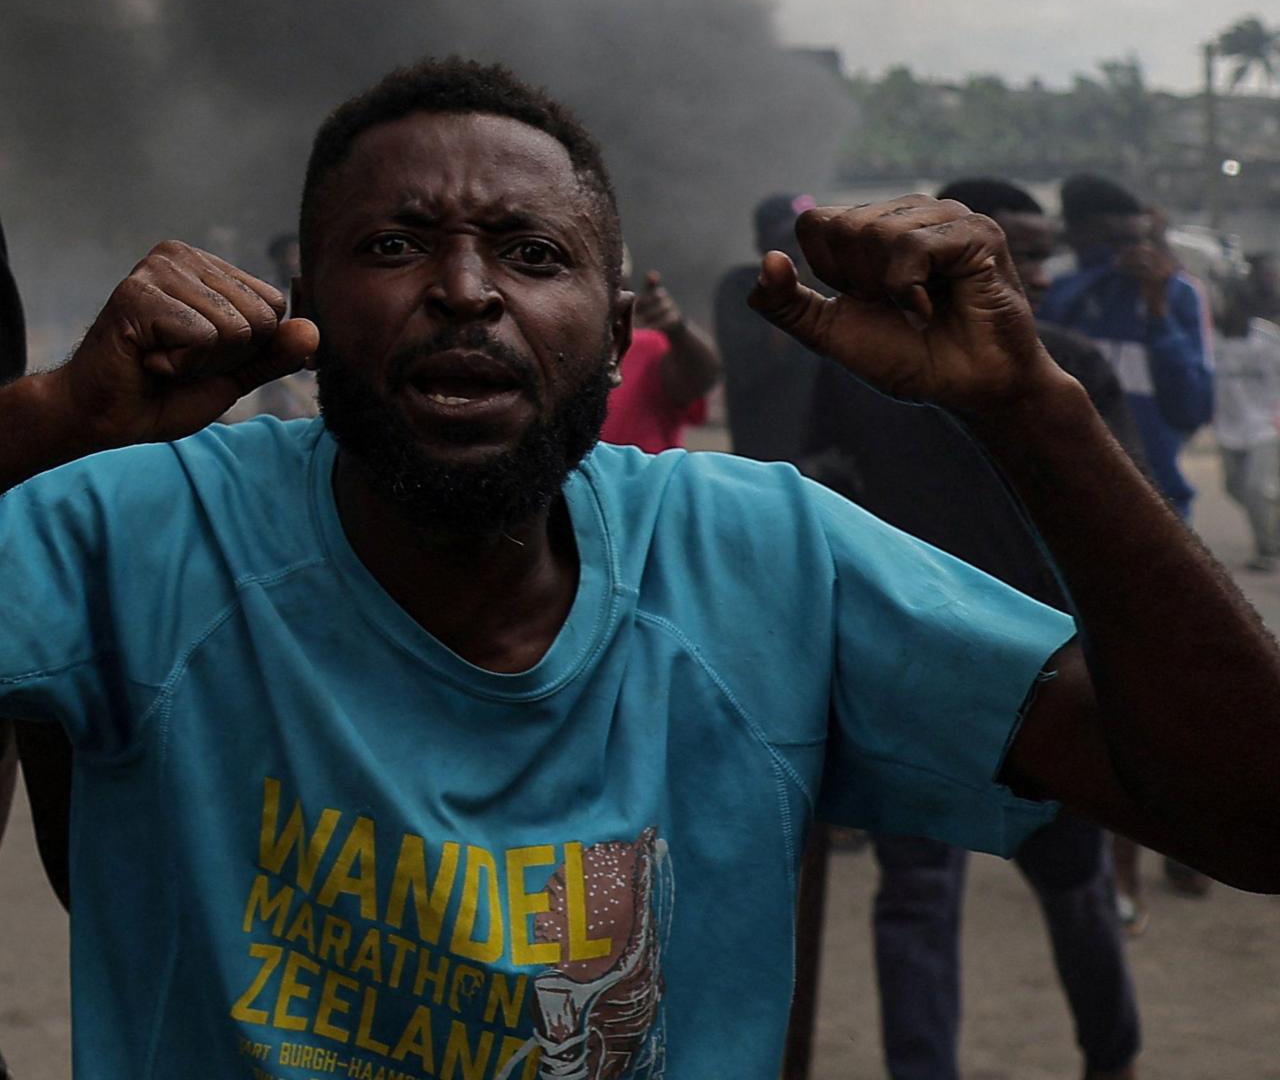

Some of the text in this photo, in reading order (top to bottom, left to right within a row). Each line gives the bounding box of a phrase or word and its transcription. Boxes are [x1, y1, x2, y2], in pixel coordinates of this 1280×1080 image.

[258, 776, 614, 966] WANDEL
[229, 942, 543, 1080] ZEELAND
[242, 874, 529, 1028] MARATHON
[278, 1041, 420, 1080] BURGH-HAAM
